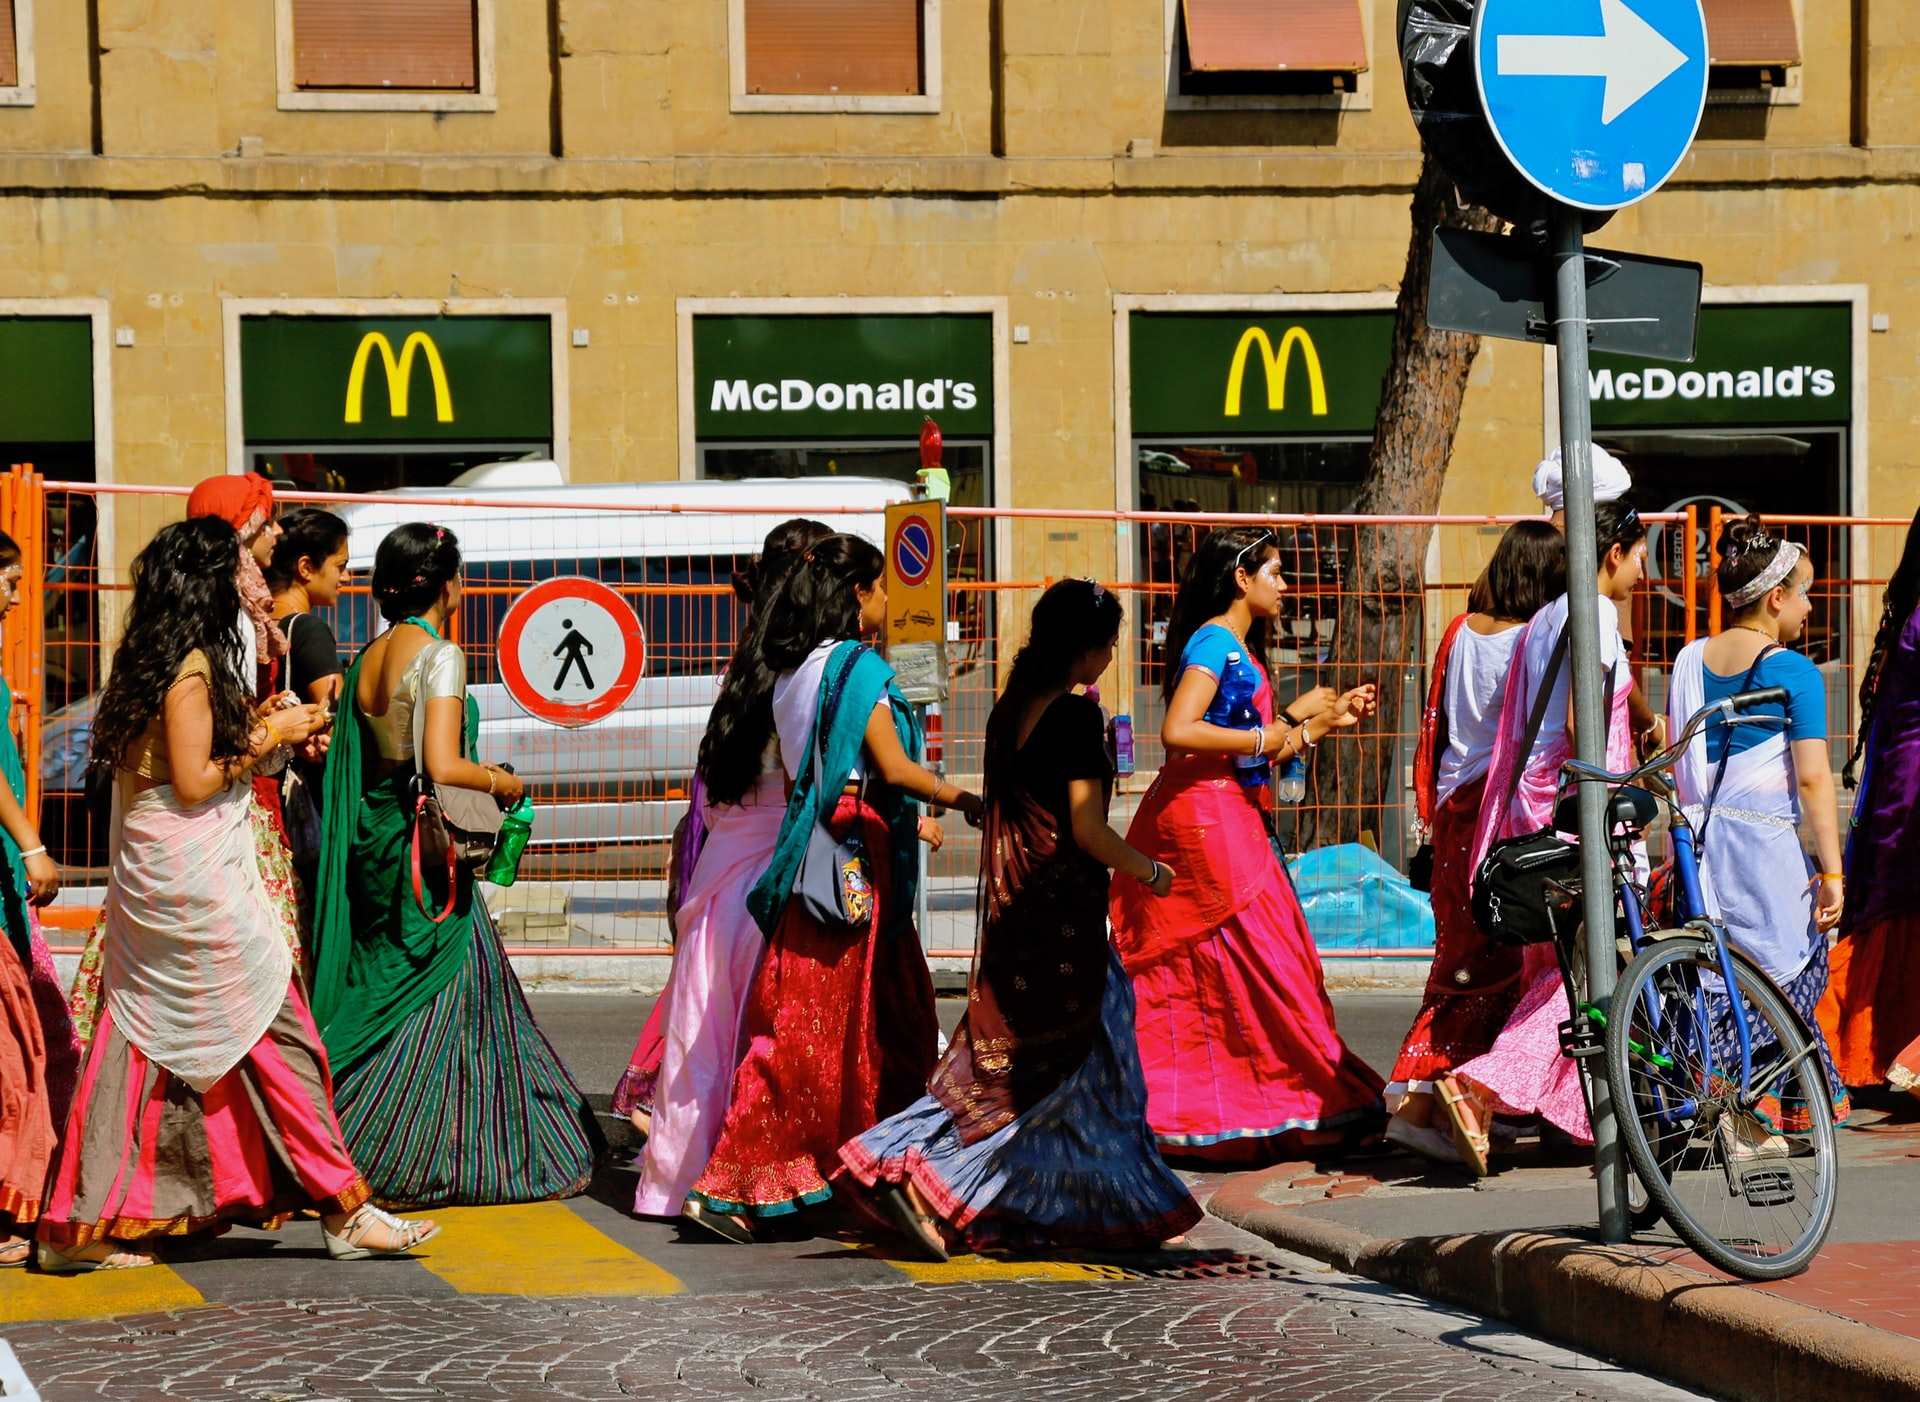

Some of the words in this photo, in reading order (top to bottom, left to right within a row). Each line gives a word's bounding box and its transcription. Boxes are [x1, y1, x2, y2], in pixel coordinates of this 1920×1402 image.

[344, 331, 455, 424] M
[710, 378, 978, 411] McDonald's
[1224, 326, 1329, 416] M
[1588, 365, 1837, 401] McDonald's
[1673, 529, 1684, 577] APERTO
